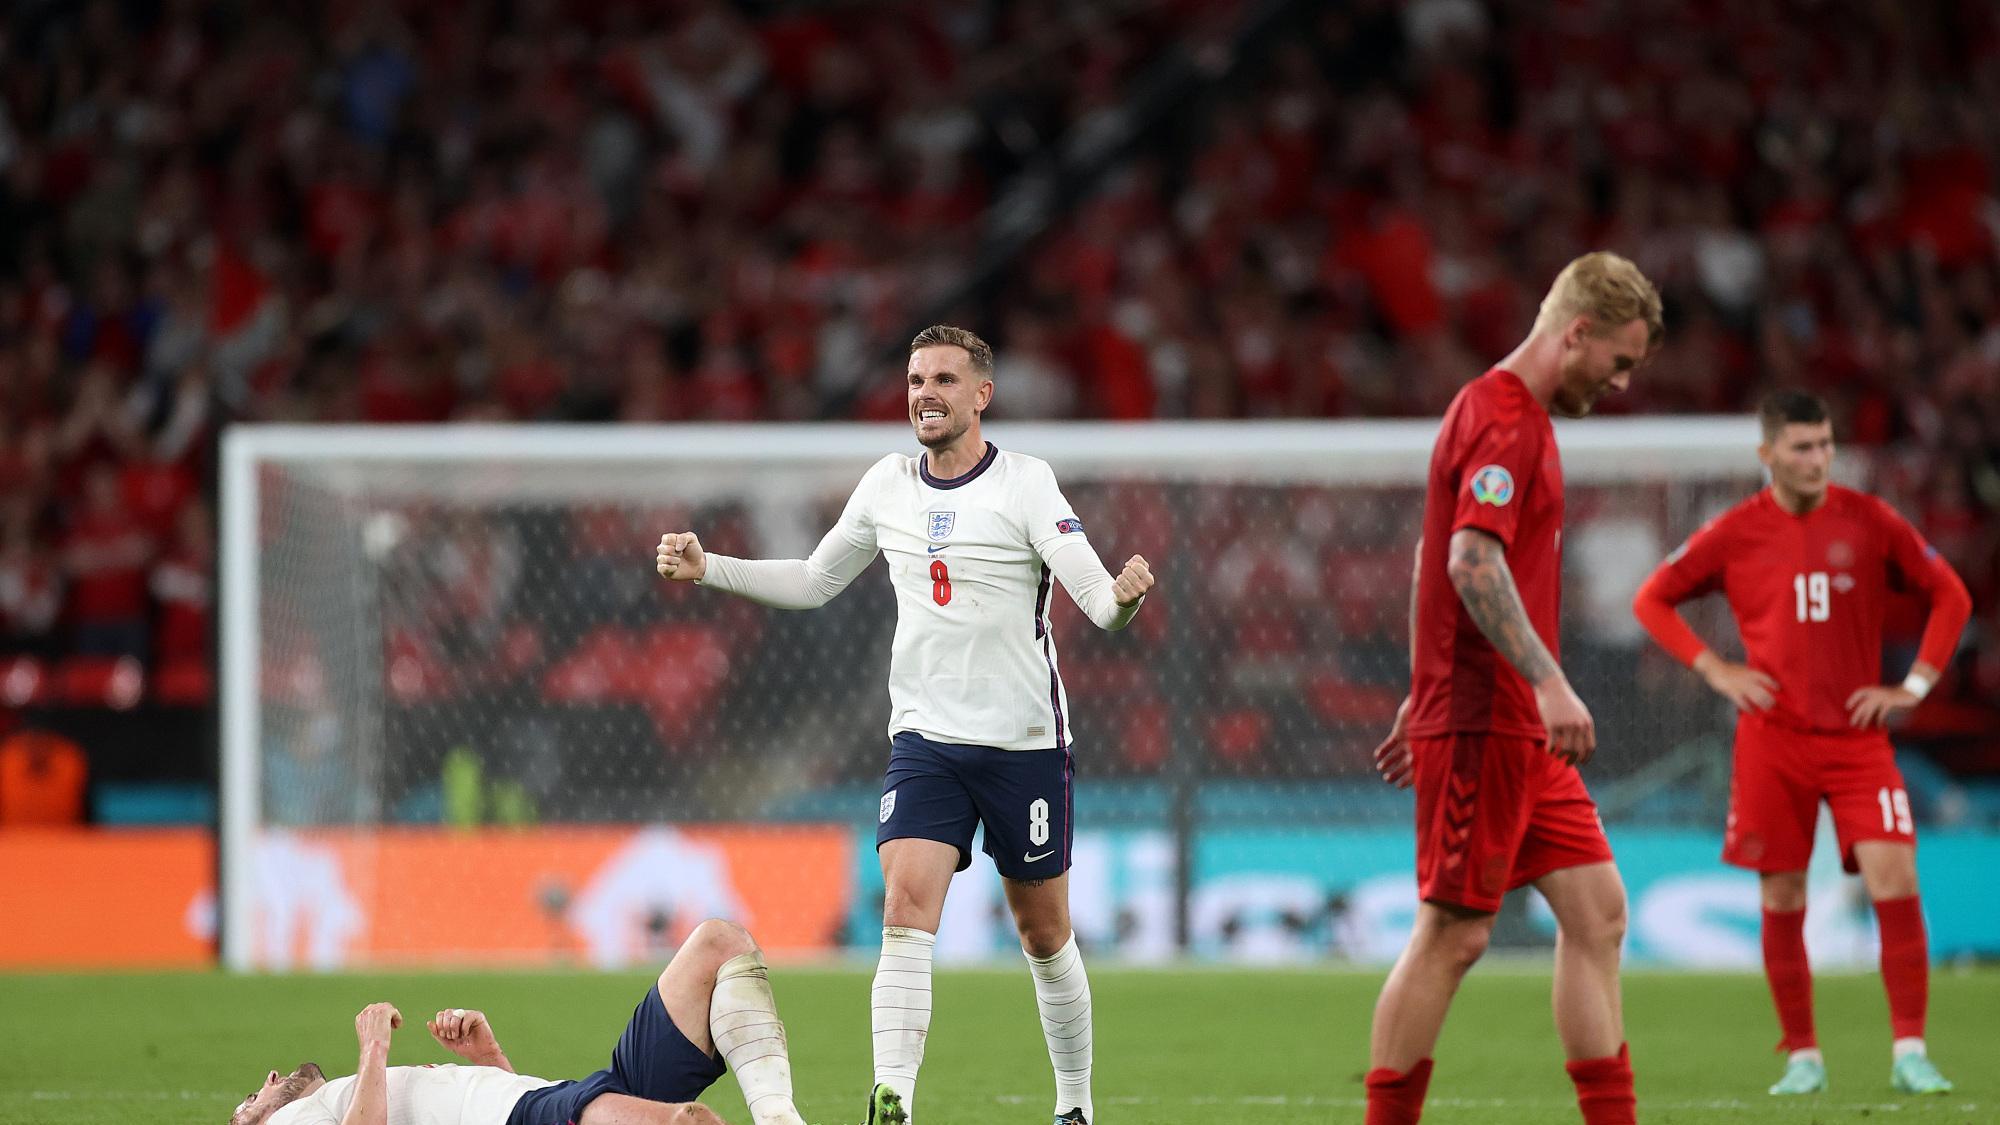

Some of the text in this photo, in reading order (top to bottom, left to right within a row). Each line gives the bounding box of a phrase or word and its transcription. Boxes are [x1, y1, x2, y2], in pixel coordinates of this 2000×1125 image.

[930, 560, 951, 606] 8
[1793, 572, 1830, 623] 19
[1029, 798, 1049, 846] 8
[1878, 786, 1914, 836] 19
